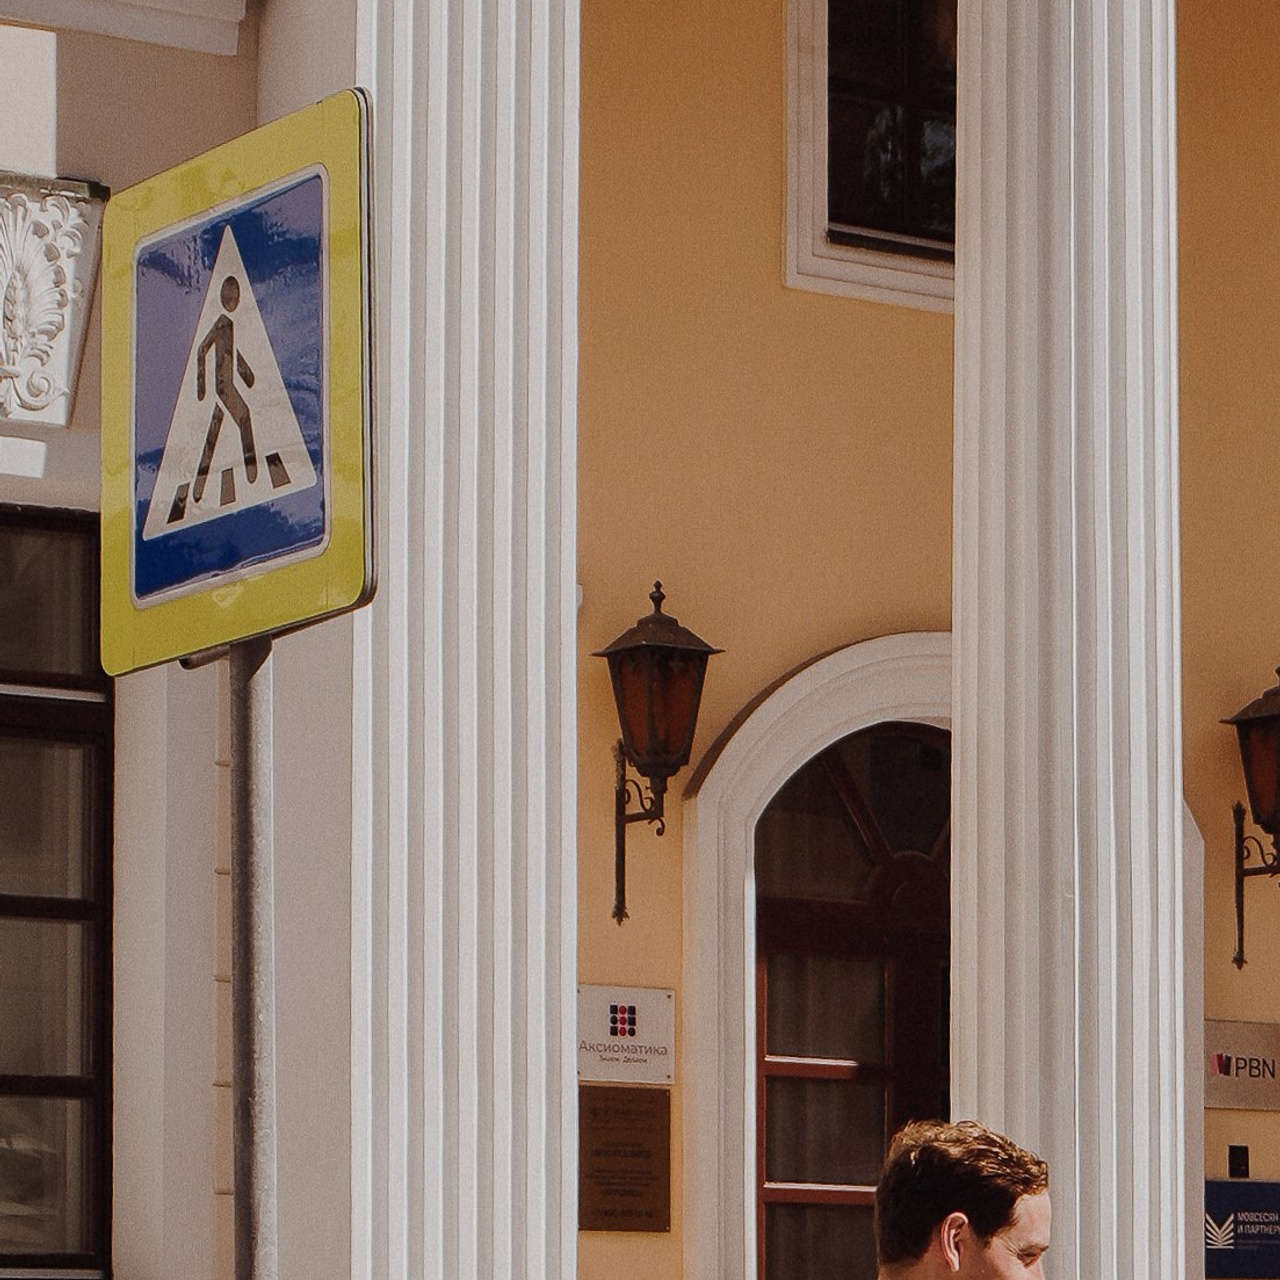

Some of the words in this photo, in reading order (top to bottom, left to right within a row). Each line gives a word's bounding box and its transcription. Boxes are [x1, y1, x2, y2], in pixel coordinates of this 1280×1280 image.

[580, 1040, 668, 1056] Аксиоматика
[1235, 1056, 1276, 1079] PBN
[1237, 1212, 1279, 1222] МОВСЕСЯН
